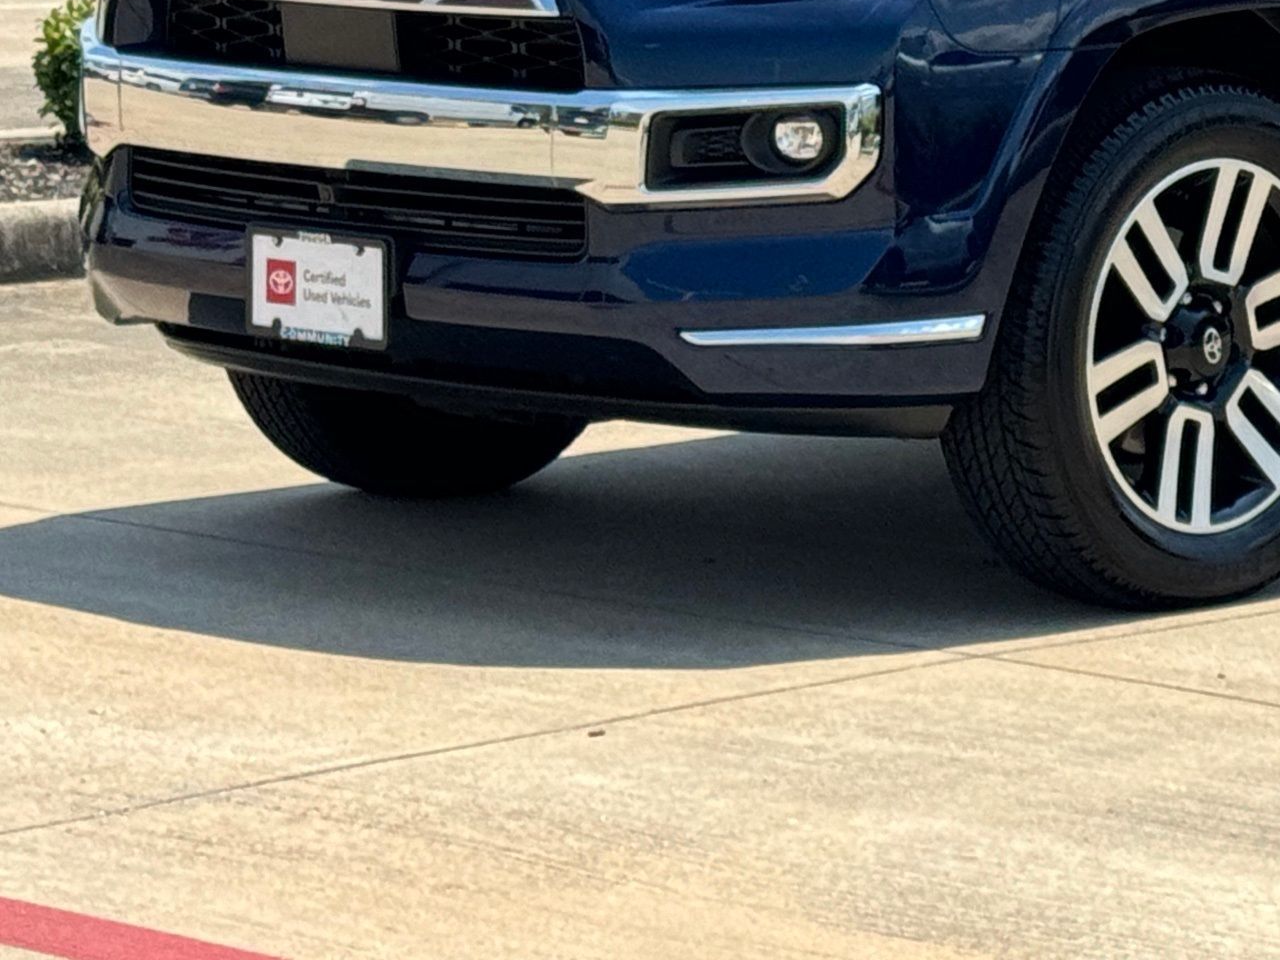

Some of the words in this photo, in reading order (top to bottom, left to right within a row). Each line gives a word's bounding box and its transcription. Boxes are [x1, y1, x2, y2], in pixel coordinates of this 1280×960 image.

[303, 268, 347, 288] Certified
[303, 287, 328, 304] Used
[330, 291, 372, 310] Vehicles
